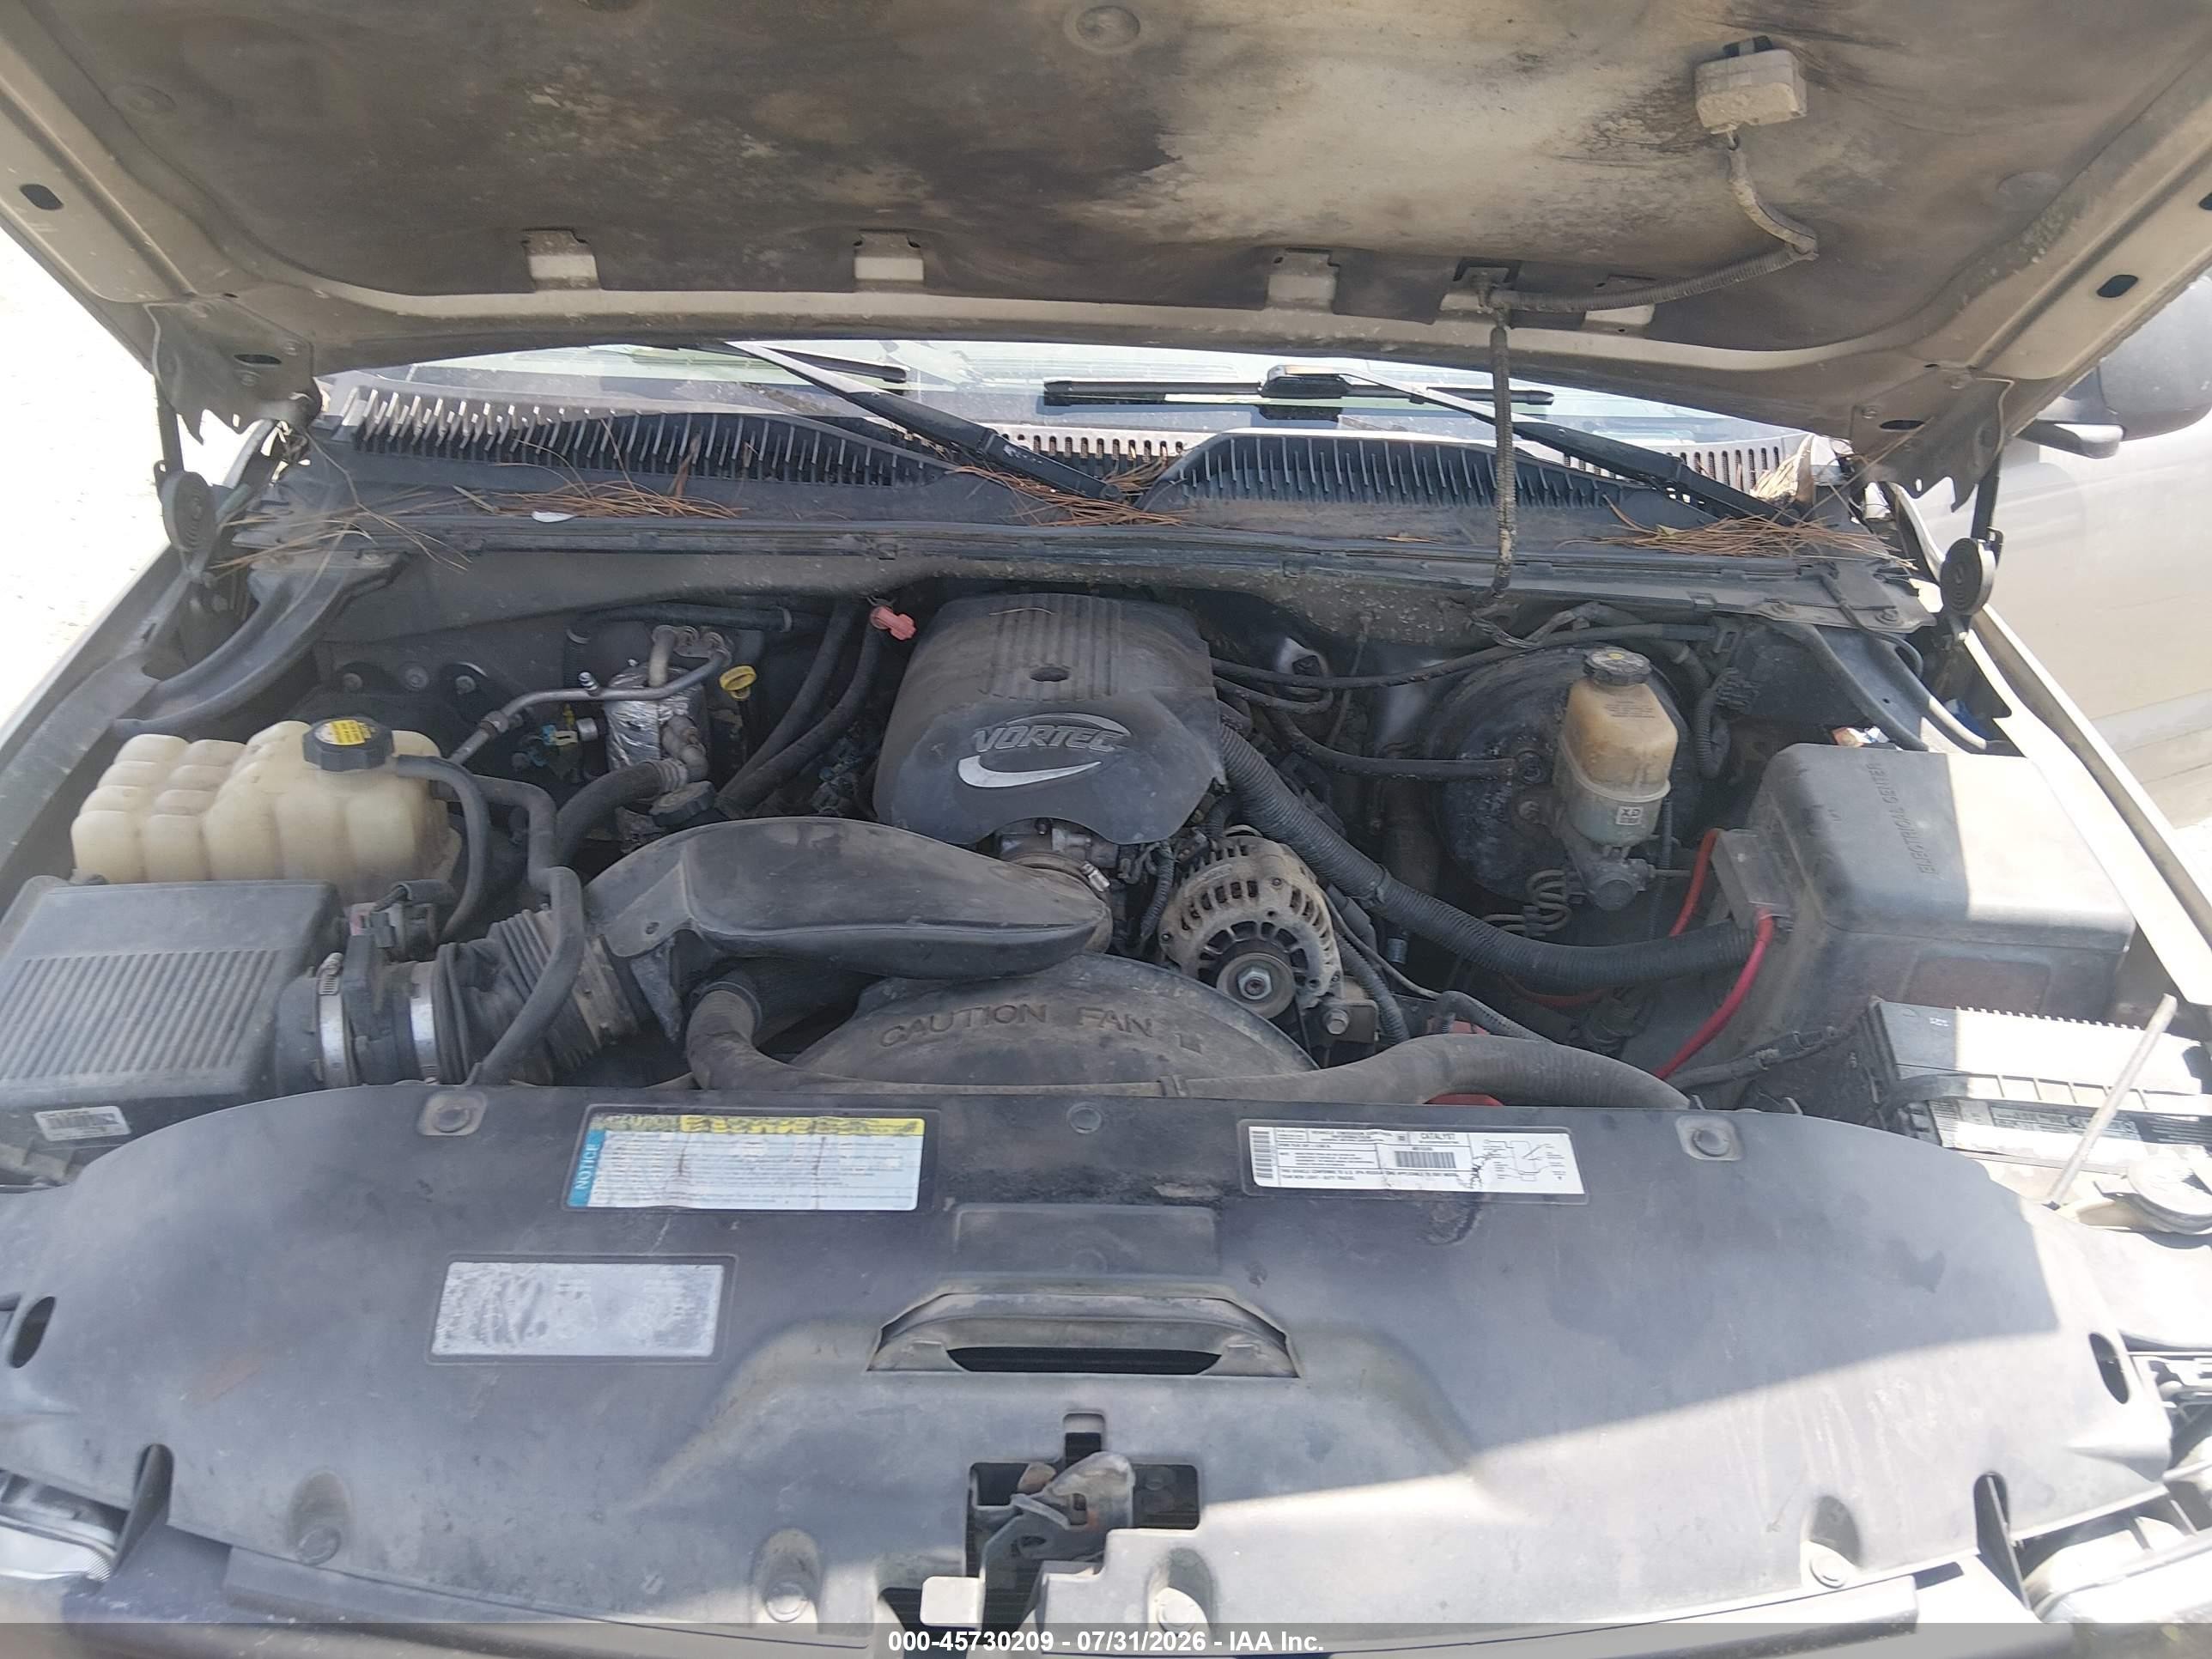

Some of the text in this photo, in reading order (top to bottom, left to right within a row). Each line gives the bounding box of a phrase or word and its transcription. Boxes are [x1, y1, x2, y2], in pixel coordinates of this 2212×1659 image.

[971, 724, 1124, 753] VORTEC
[1889, 807, 1939, 874] ELECTRICAL
[879, 1003, 1154, 1048] CAUTION FAN
[574, 1143, 599, 1190] NOTICE
